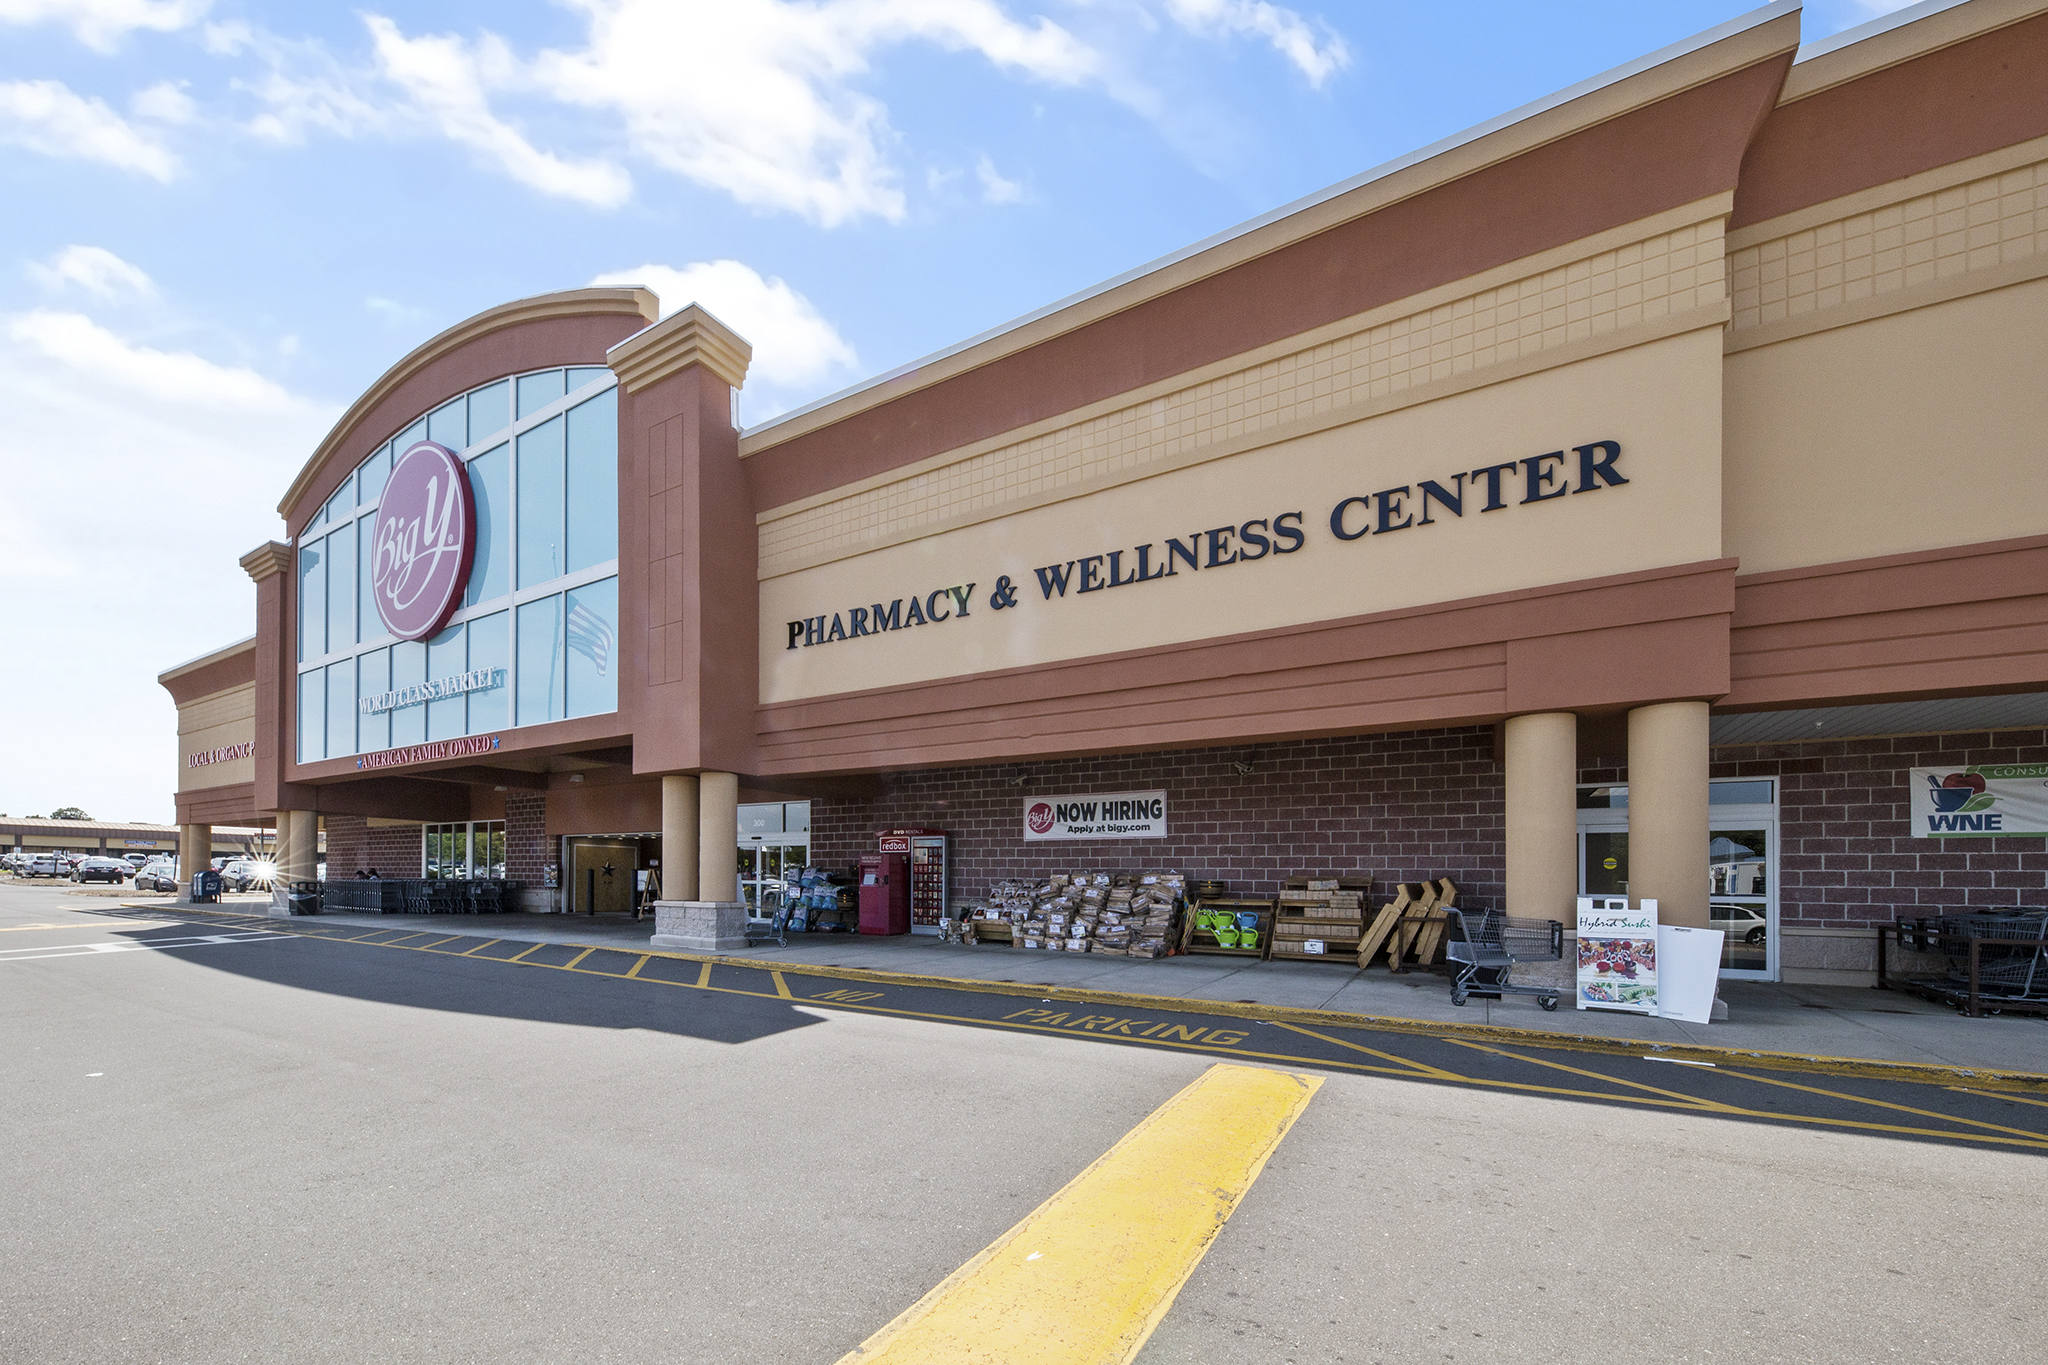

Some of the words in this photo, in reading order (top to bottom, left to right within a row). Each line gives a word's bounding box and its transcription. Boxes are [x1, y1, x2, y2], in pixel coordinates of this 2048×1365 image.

[786, 583, 976, 650] PHARMACY
[989, 575, 1018, 610] &
[1033, 511, 1306, 600] WELLNESS
[1329, 439, 1630, 541] CENTER
[374, 516, 421, 599] Big
[358, 690, 397, 714] WORLD
[400, 680, 435, 705] CLASS
[436, 666, 494, 697] MARKET
[188, 751, 210, 768] LOCAL
[210, 749, 217, 764] &
[216, 742, 250, 763] ORGANIC
[361, 748, 410, 769] AMERICAN
[411, 741, 449, 762] FAMILY
[450, 735, 492, 757] OWNED
[1056, 802, 1097, 822] NOW
[1101, 799, 1162, 821] HIRING
[1928, 814, 2002, 831] WNE
[1067, 825, 1094, 834] Apply
[1096, 824, 1105, 832] at
[1107, 823, 1151, 833] bigy.com
[882, 842, 906, 850] redbox
[1579, 916, 1619, 930] Hybrid
[1620, 917, 1652, 928] Sushi
[810, 988, 885, 1002] NO
[1002, 1008, 1250, 1045] PARKING
